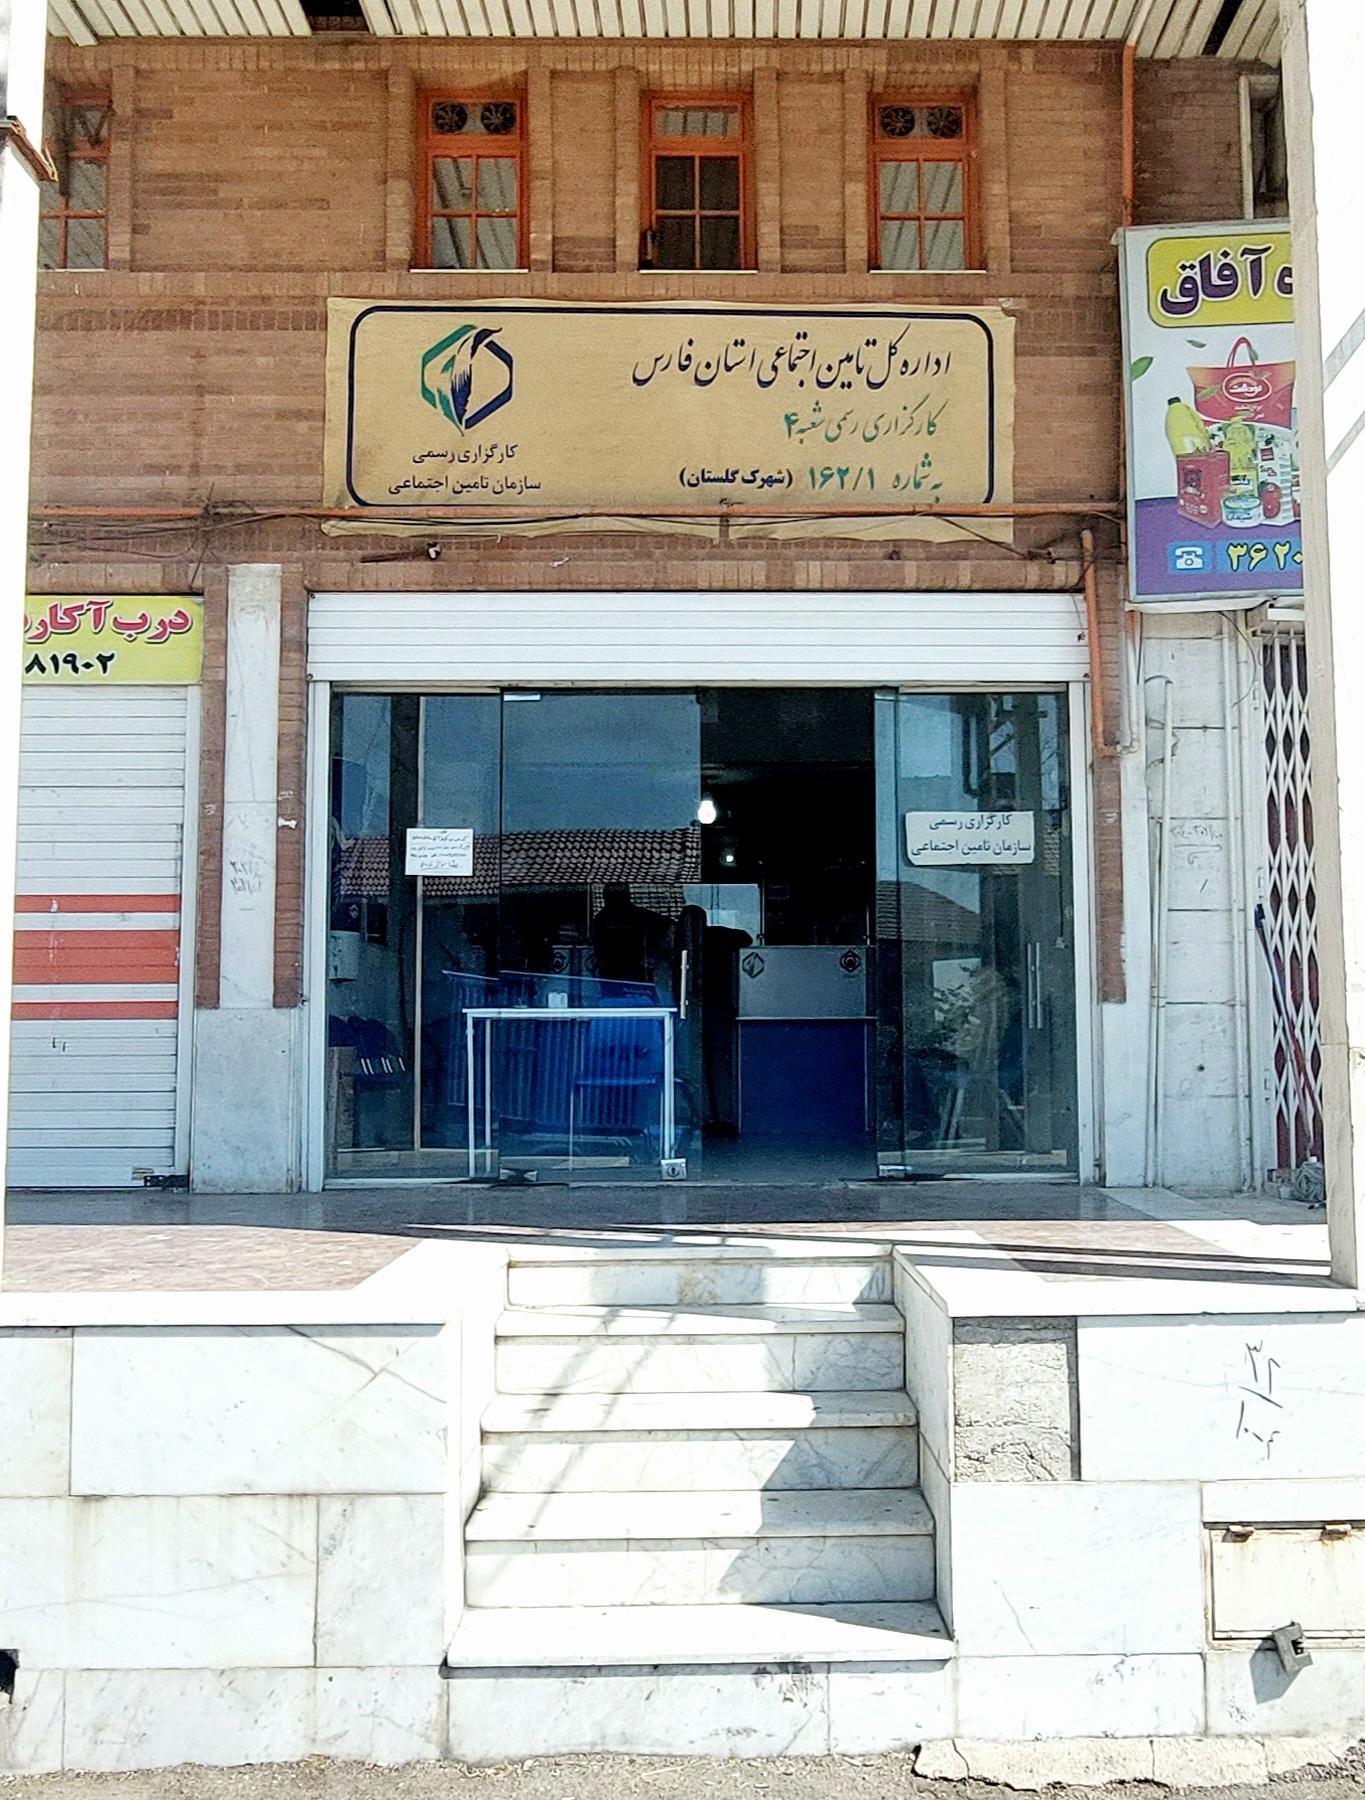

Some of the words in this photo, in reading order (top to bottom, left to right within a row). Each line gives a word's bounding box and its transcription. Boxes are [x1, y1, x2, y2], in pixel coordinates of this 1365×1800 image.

[1160, 246, 1272, 315] آفاق
[633, 338, 694, 386] فارس
[695, 338, 757, 386] استان
[757, 331, 816, 388] اجتماعی
[816, 338, 877, 389] تامین
[866, 322, 911, 389] کل
[900, 349, 951, 377] اداره
[825, 409, 859, 443] رسمی
[412, 450, 456, 463] رسمی
[457, 444, 518, 463] کارگزاری
[388, 475, 448, 495] اجتماعی
[452, 475, 490, 495] تامین
[492, 475, 541, 495] سازمان
[113, 609, 192, 641] درب
[929, 818, 963, 831] رسمی
[911, 840, 959, 856] اجتماعی
[961, 840, 991, 855] تامین
[992, 840, 1031, 856] سازمان
